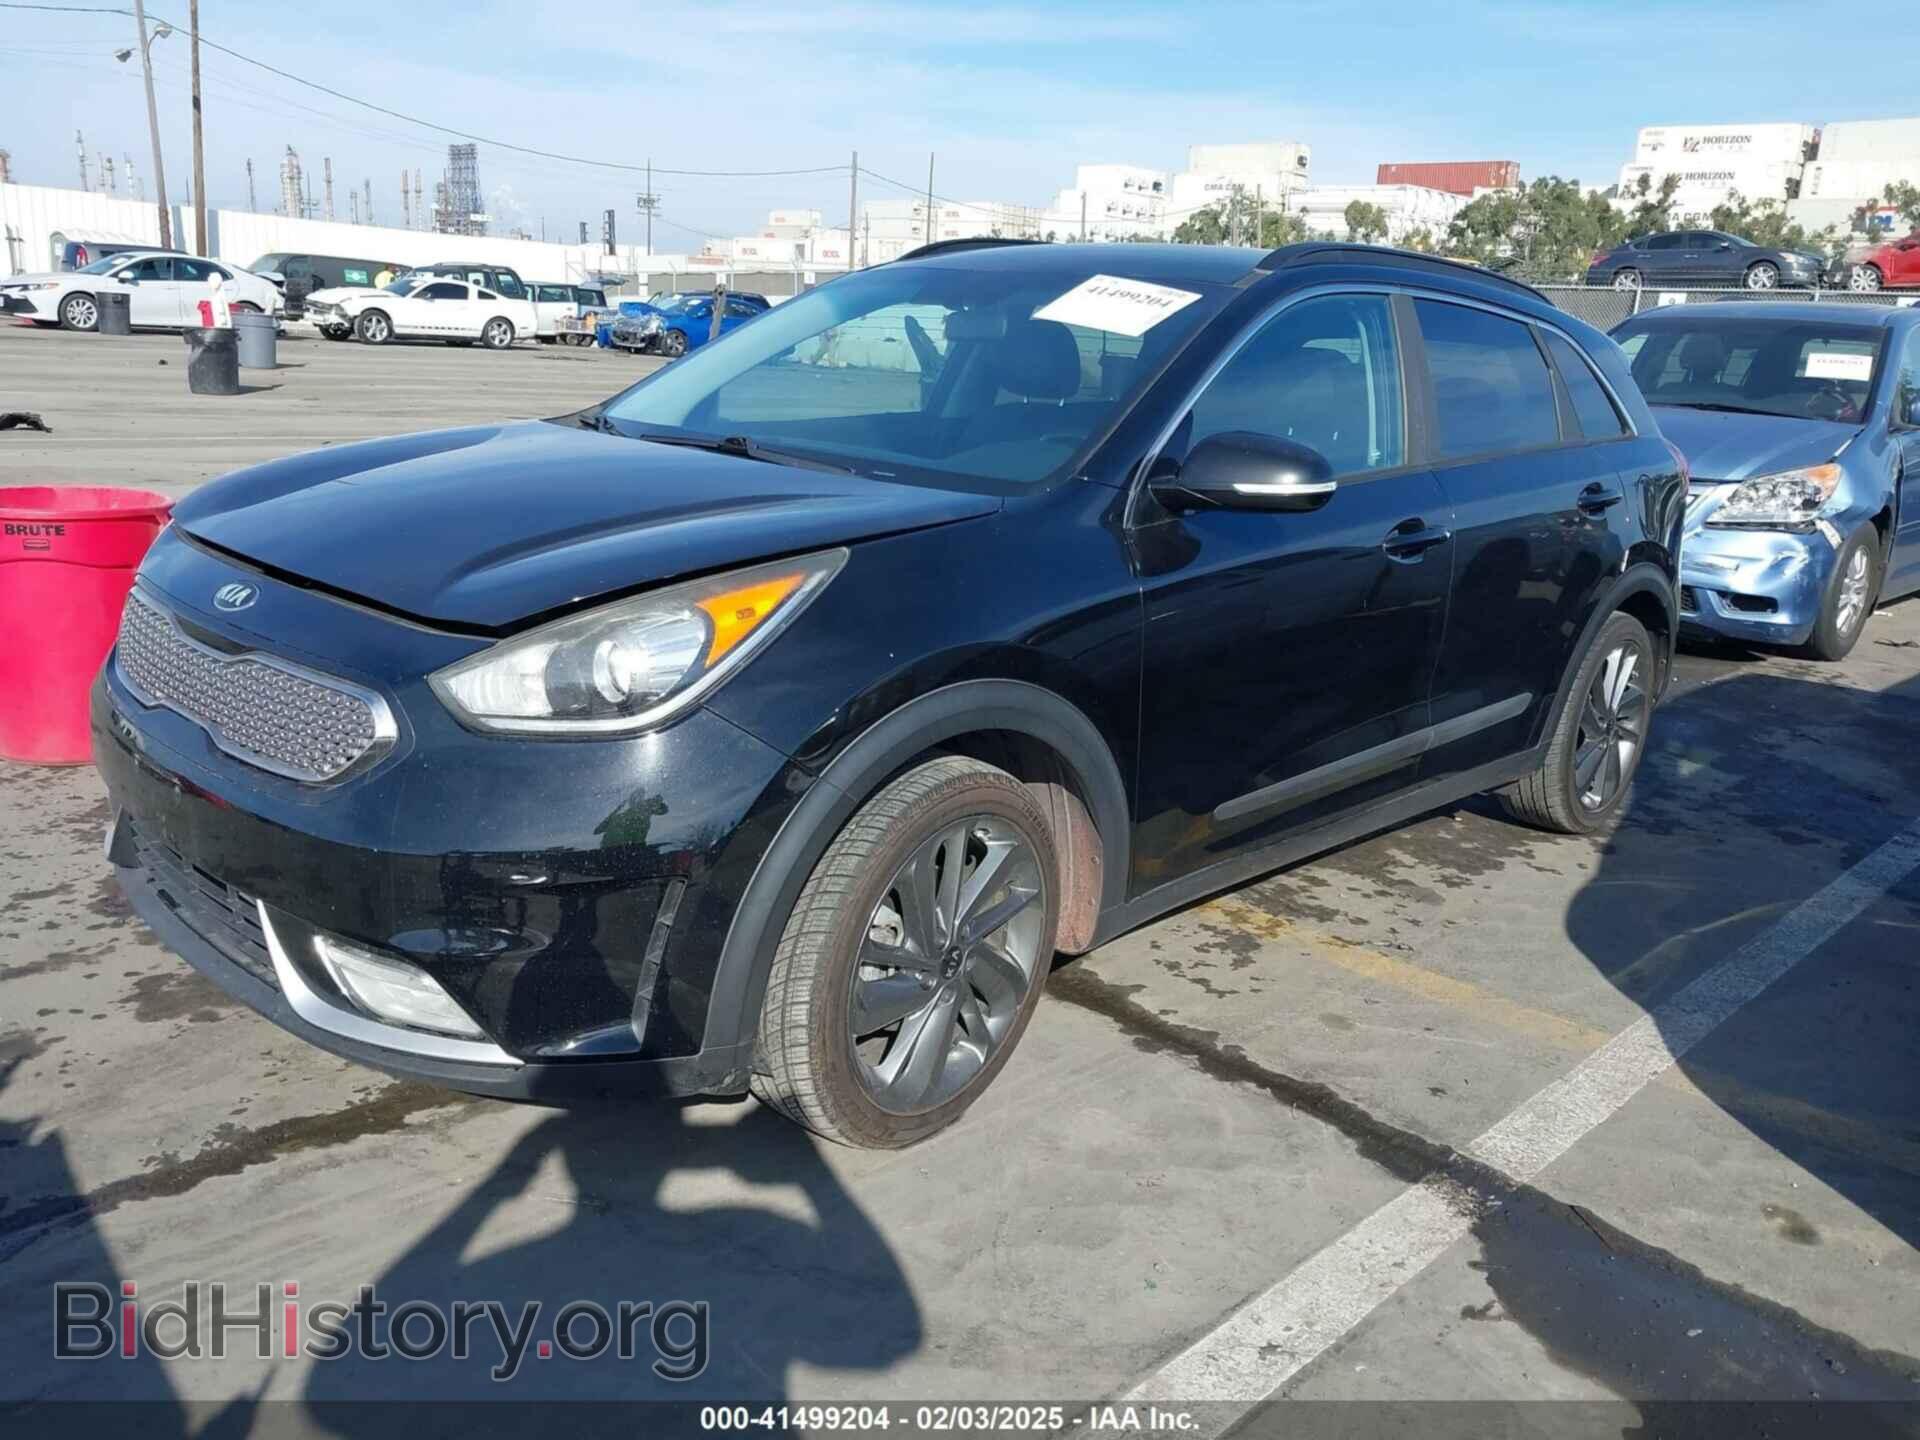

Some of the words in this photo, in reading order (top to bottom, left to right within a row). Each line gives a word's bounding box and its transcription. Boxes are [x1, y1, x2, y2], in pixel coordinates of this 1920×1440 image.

[1702, 135, 1752, 145] HORIZON
[1684, 172, 1735, 181] HORIZON
[5, 524, 65, 536] BRUTE
[214, 583, 257, 609] KIA
